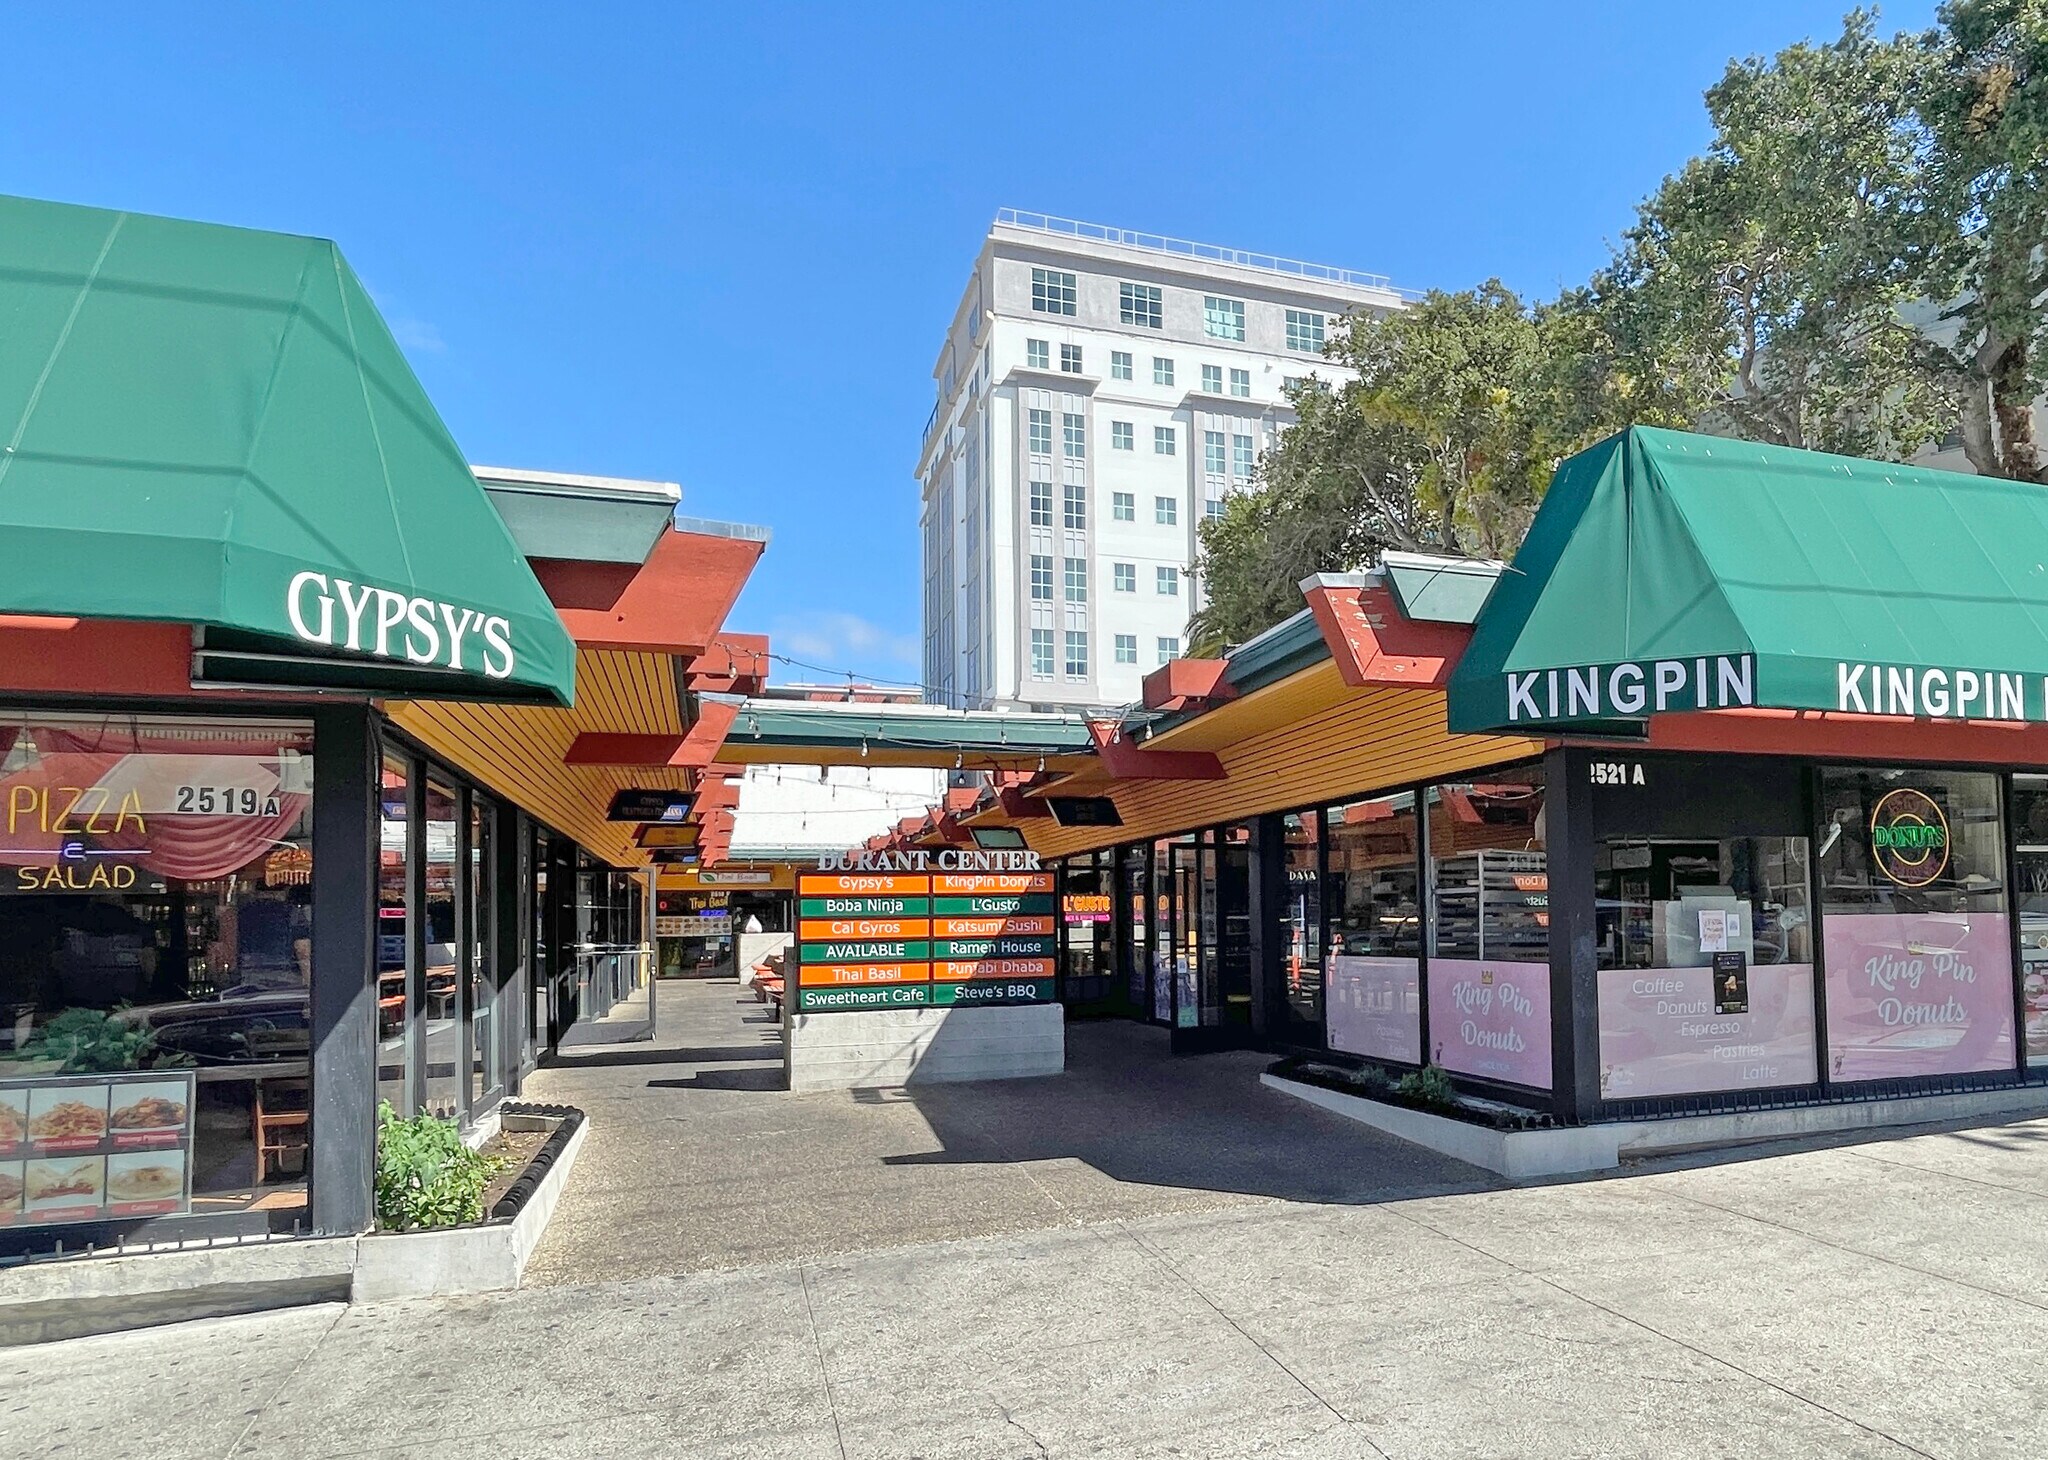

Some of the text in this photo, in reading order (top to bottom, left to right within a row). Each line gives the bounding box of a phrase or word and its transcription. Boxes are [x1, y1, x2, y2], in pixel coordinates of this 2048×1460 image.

[287, 571, 515, 679] GYPSY'S
[1507, 654, 1753, 720] KINGPIN
[1838, 662, 2025, 721] KINGPIN
[1632, 764, 1646, 786] A
[8, 785, 147, 834] PIZZA
[1874, 825, 1946, 849] DONUTS
[817, 850, 1042, 871] DURANT CENTER
[17, 862, 136, 890] SALAD
[839, 876, 894, 891] Gypsy's
[945, 875, 1046, 889] KingPin Donuts
[826, 899, 904, 914] Boba Ninja
[972, 899, 1021, 911] L'Gusto
[831, 920, 901, 936] Cal Gyros
[948, 920, 1042, 933] Katsumi Sushi
[826, 944, 905, 958] AVAILABLE
[950, 941, 1042, 954] Ramen House
[832, 966, 901, 981] Thai Basil
[947, 961, 1044, 976] Punjabi Dhaba
[1864, 953, 1977, 992] King Pin
[954, 984, 1037, 999] Steve's BBQ
[1632, 978, 1684, 995] Coffee
[805, 988, 925, 1006] Sweetheart Cafe
[1452, 981, 1533, 1017] King Pin
[1657, 1000, 1708, 1015] Donuts
[1878, 995, 1968, 1026] Donuts
[1461, 1020, 1526, 1053] Donuts
[1681, 1021, 1740, 1037] Espresso
[1713, 1043, 1766, 1059] Pastries
[1743, 1065, 1778, 1080] Latte
